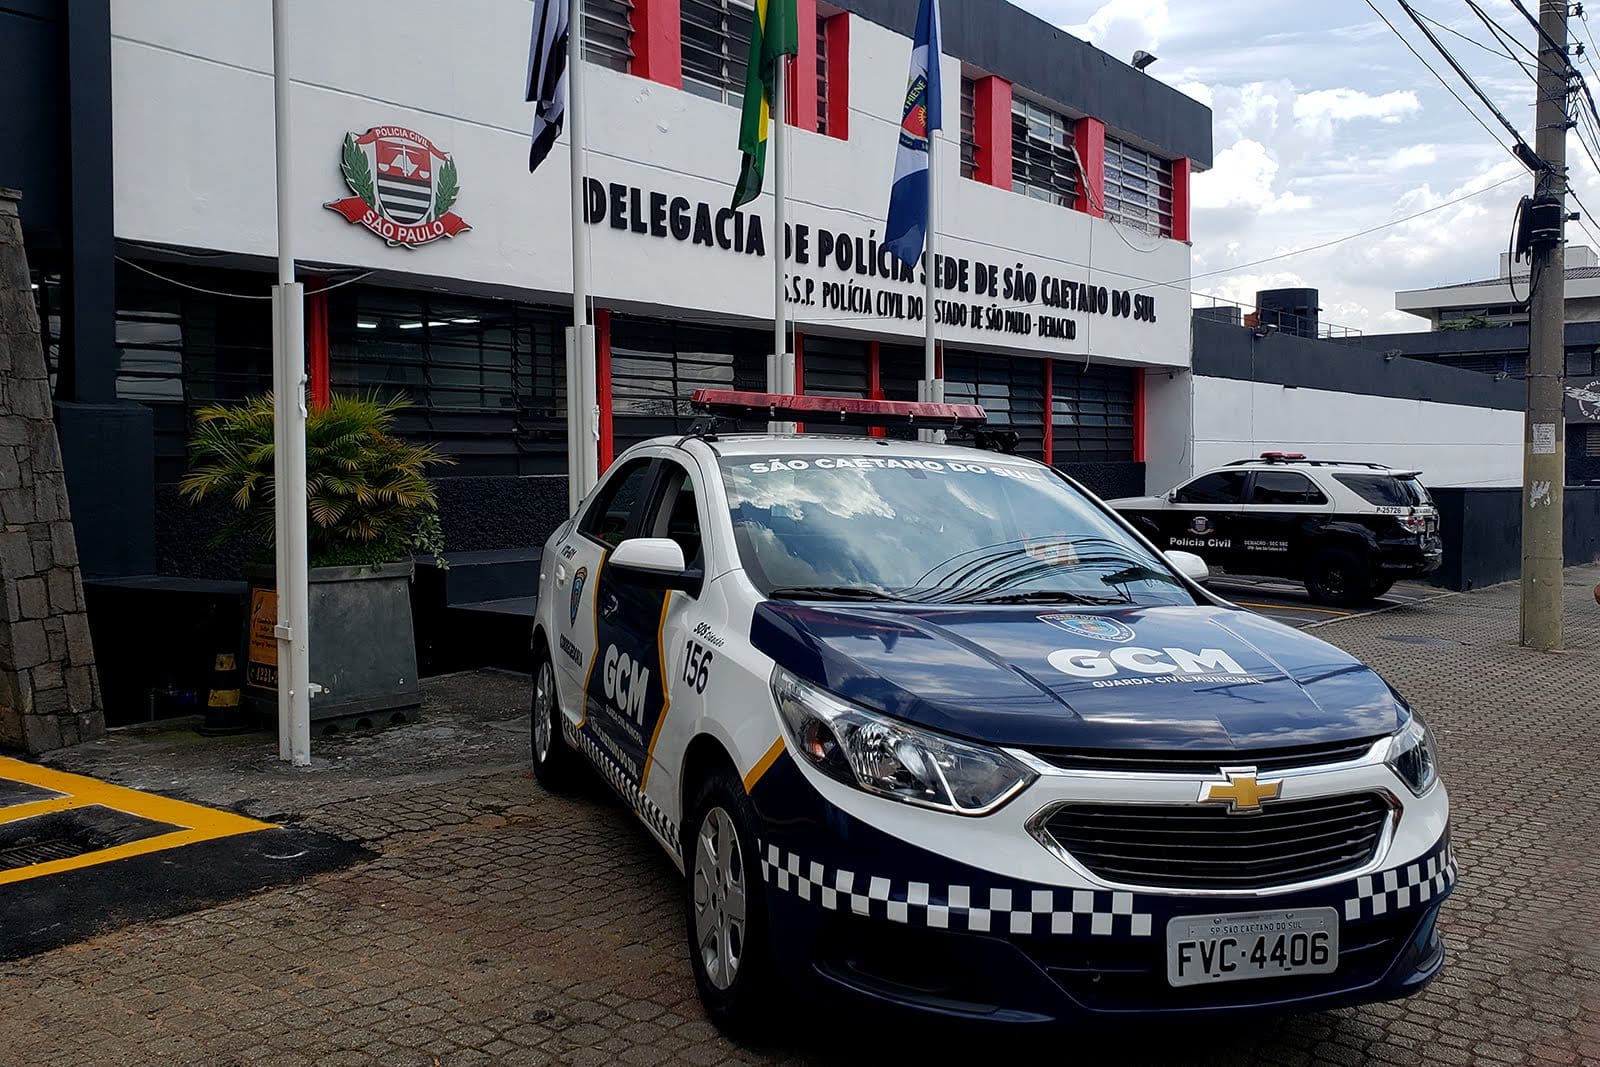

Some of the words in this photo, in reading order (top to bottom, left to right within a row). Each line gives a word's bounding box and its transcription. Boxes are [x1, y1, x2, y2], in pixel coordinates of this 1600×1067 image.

[409, 132, 429, 148] CIVIL
[397, 221, 444, 242] PAULO
[583, 176, 765, 257] DELEGACIA
[818, 229, 914, 284] POLÍCIA
[975, 261, 998, 297] DE
[1003, 262, 1036, 303] SÃO
[1041, 275, 1108, 315] CAETANO
[1112, 290, 1131, 318] DO
[1134, 293, 1157, 323] SUL
[822, 279, 872, 315] POLÍCIA
[877, 290, 906, 319] CIVIL
[908, 295, 923, 321] DO
[934, 299, 967, 327] STADO
[971, 305, 983, 329] DE
[985, 304, 1003, 332] SÃO
[1004, 310, 1031, 335] PAULO
[749, 458, 809, 475] SÃO
[814, 458, 945, 472] CAETANO
[947, 462, 987, 475] DO
[989, 467, 1041, 482] SUL
[1207, 538, 1231, 548] Civil
[683, 640, 713, 695] 156
[1047, 646, 1247, 678] GCM
[603, 643, 649, 726] GCM
[1092, 677, 1154, 688] GUARDA
[1155, 674, 1193, 684] CIVIL
[1192, 675, 1265, 685] MUNICIPAL
[1210, 926, 1220, 936] SP
[1240, 922, 1274, 934] CAETANO
[1276, 921, 1286, 930] DO
[1287, 920, 1302, 930] SUL
